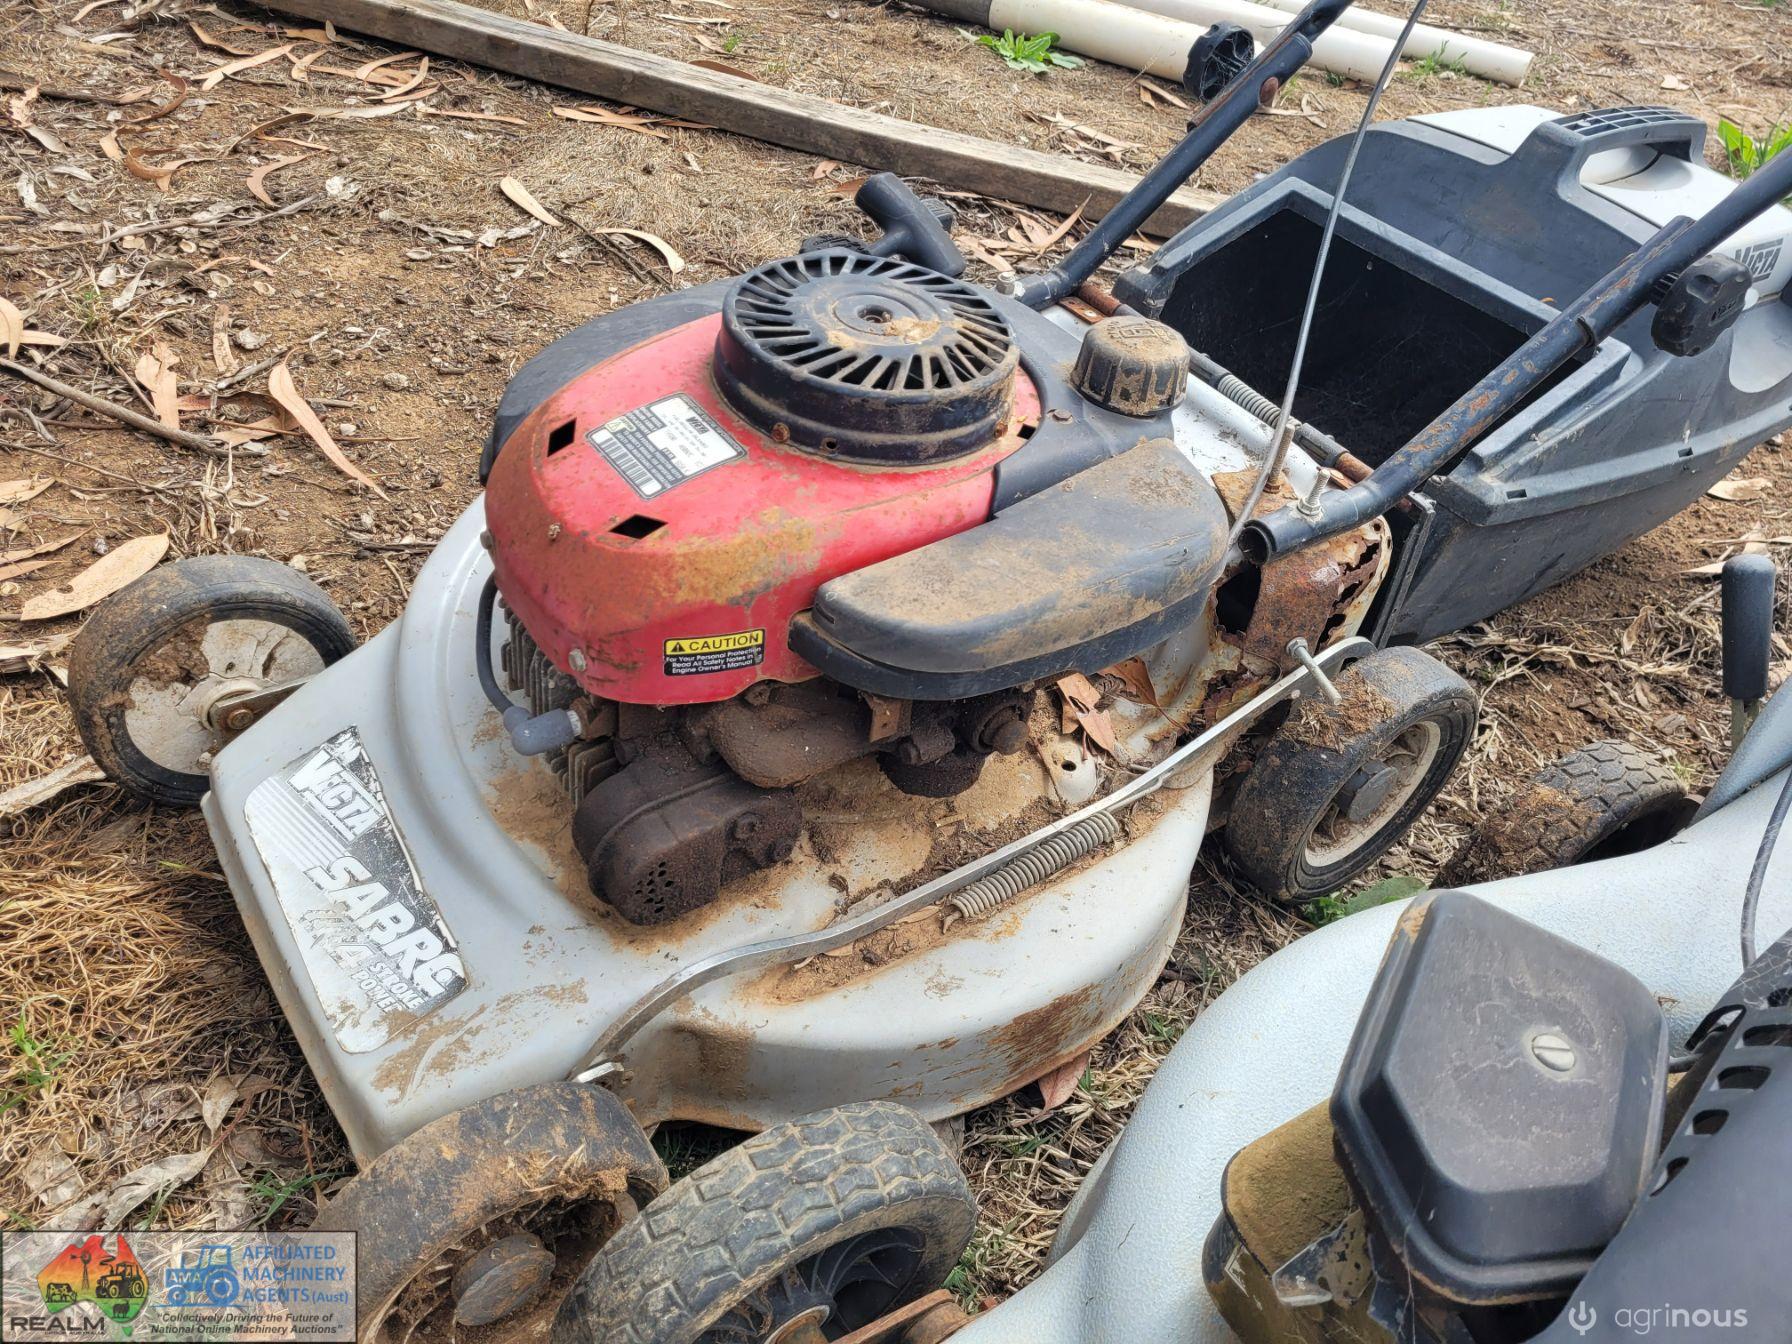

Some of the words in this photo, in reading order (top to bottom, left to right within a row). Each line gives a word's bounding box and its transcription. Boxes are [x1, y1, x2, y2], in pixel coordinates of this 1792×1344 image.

[689, 633, 759, 651] CAUTION
[696, 652, 726, 660] Personal
[728, 647, 761, 657] Protection
[672, 667, 697, 675] Engine
[728, 659, 753, 668] Manual
[703, 658, 725, 666] Safety
